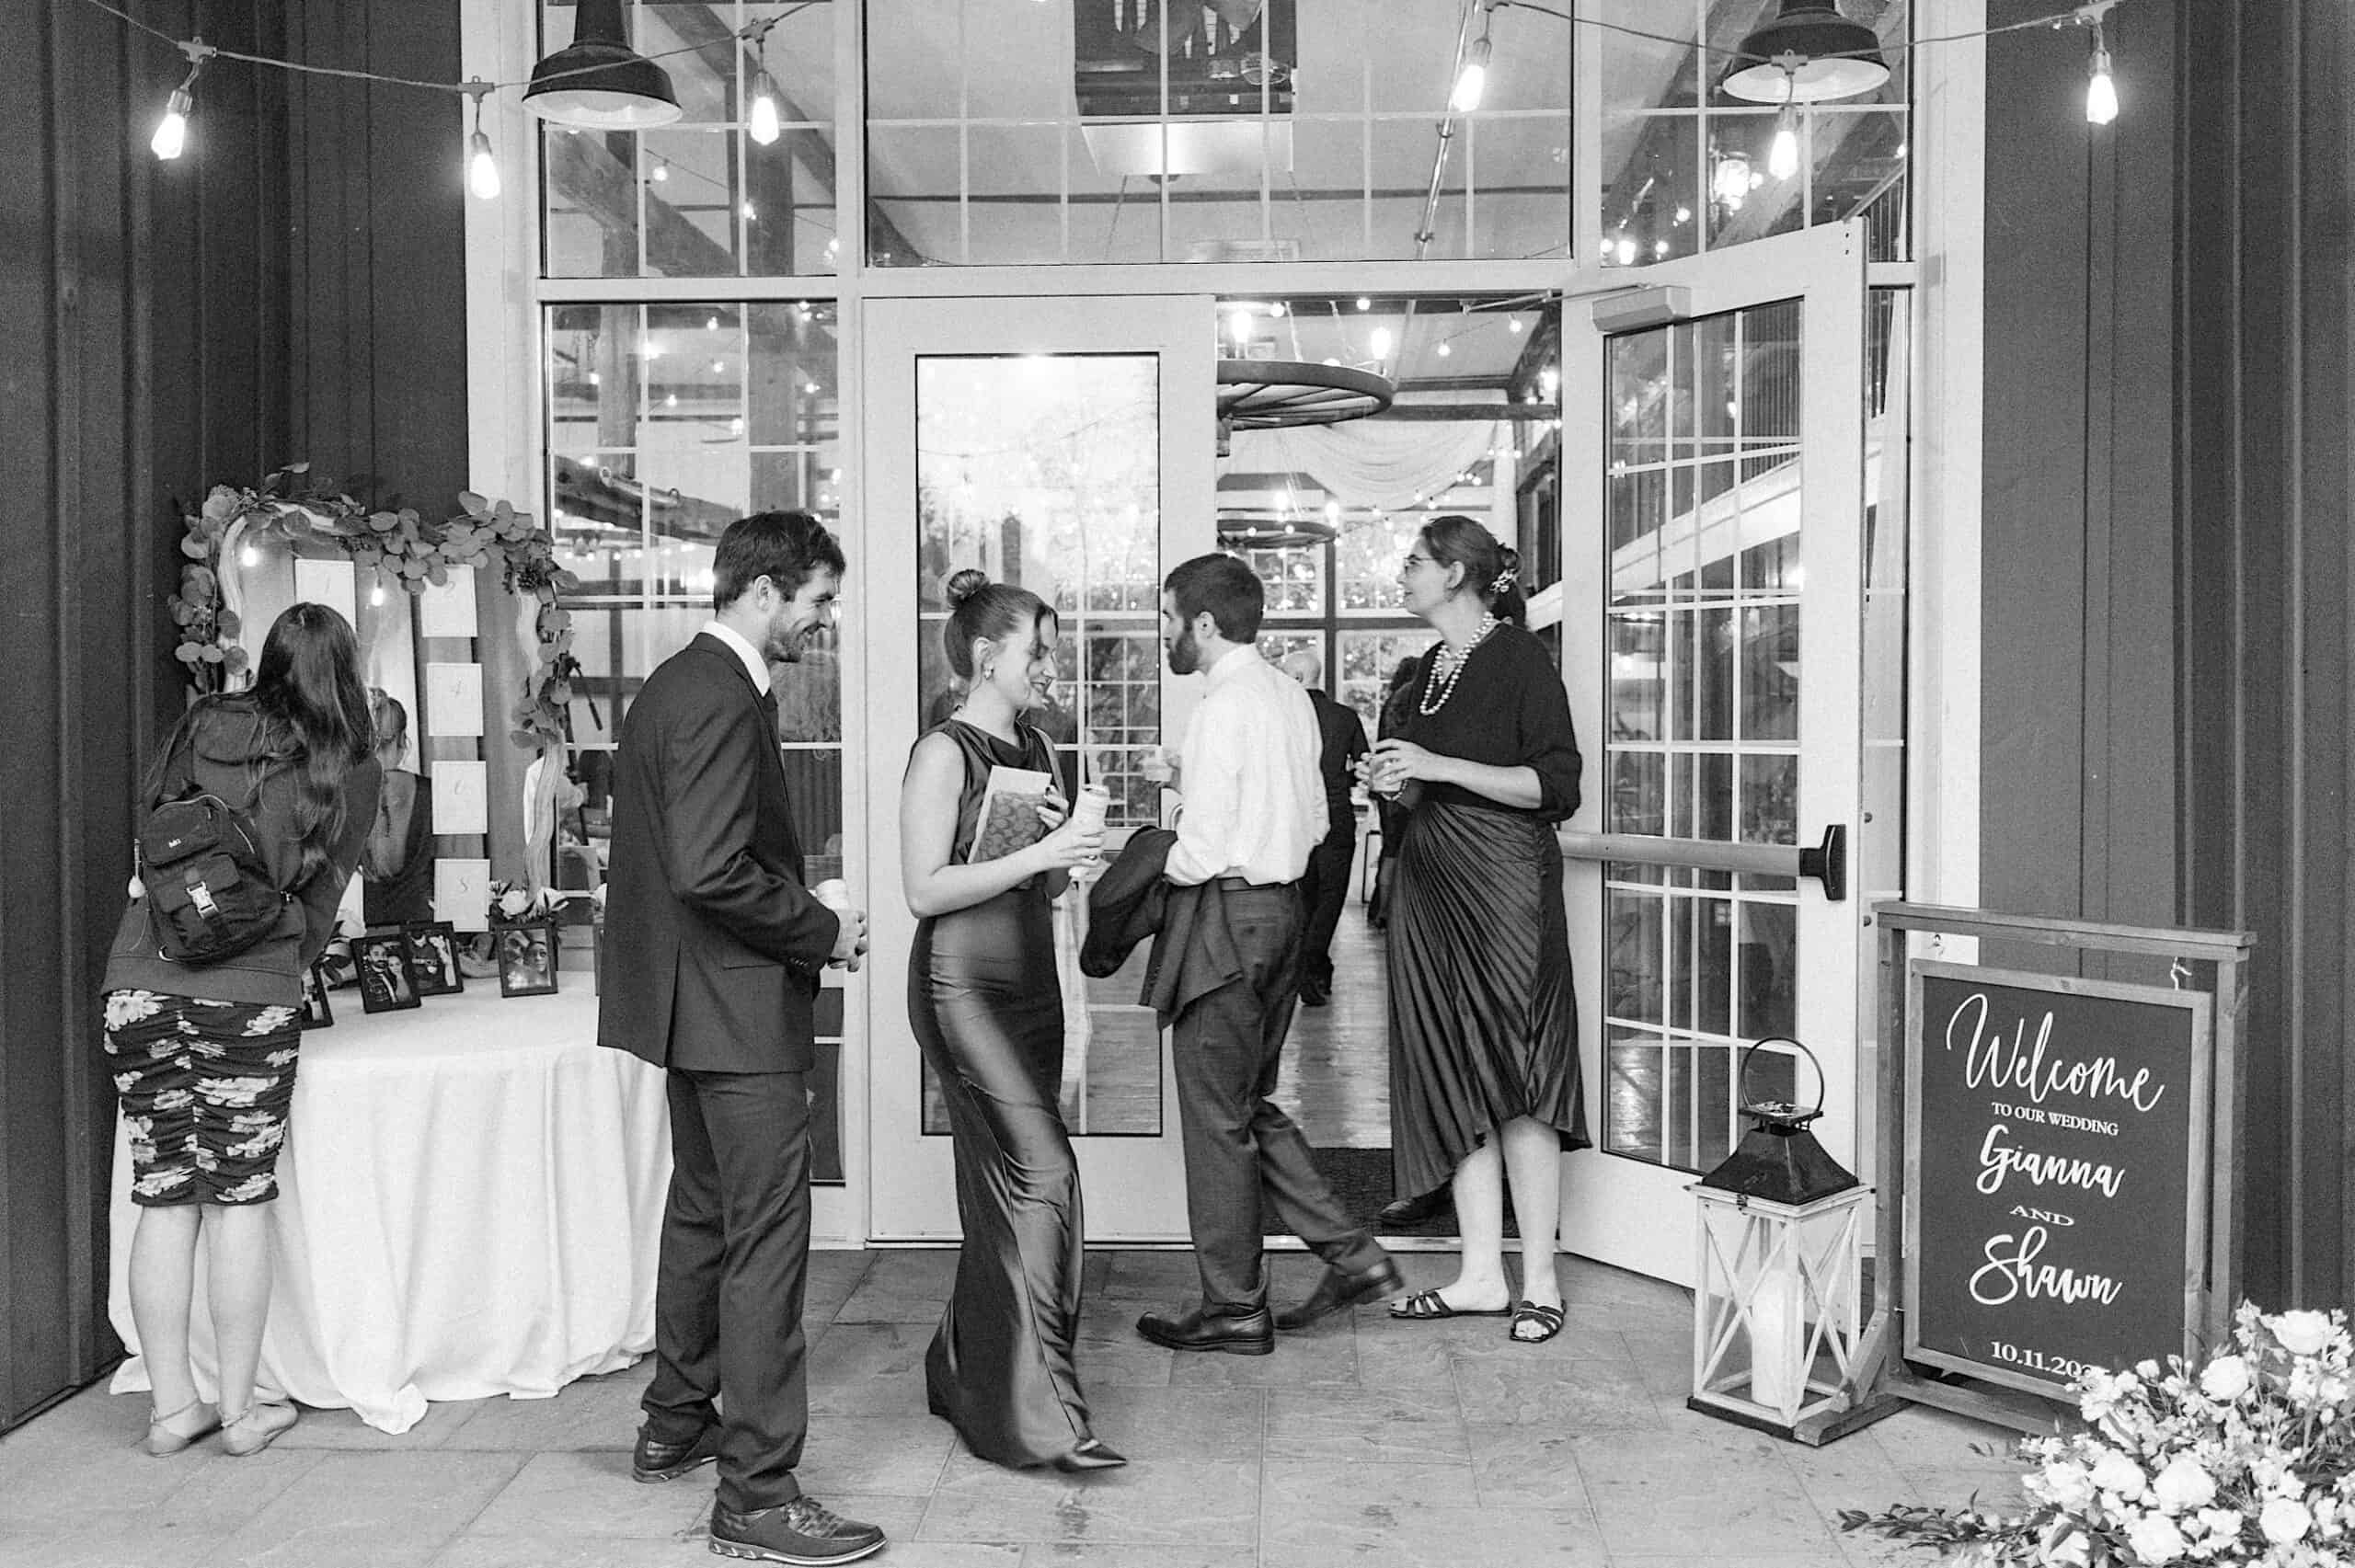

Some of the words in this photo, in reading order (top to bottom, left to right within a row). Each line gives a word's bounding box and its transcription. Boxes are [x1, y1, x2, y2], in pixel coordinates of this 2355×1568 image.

[1946, 993, 2165, 1112] Welcome
[1991, 1102, 2013, 1117] TO
[2014, 1105, 2046, 1124] OUR
[2048, 1111, 2120, 1137] WEDDING
[1977, 1124, 2126, 1198] Gianna
[2009, 1205, 2075, 1227] AND
[1969, 1225, 2123, 1306] Shawn
